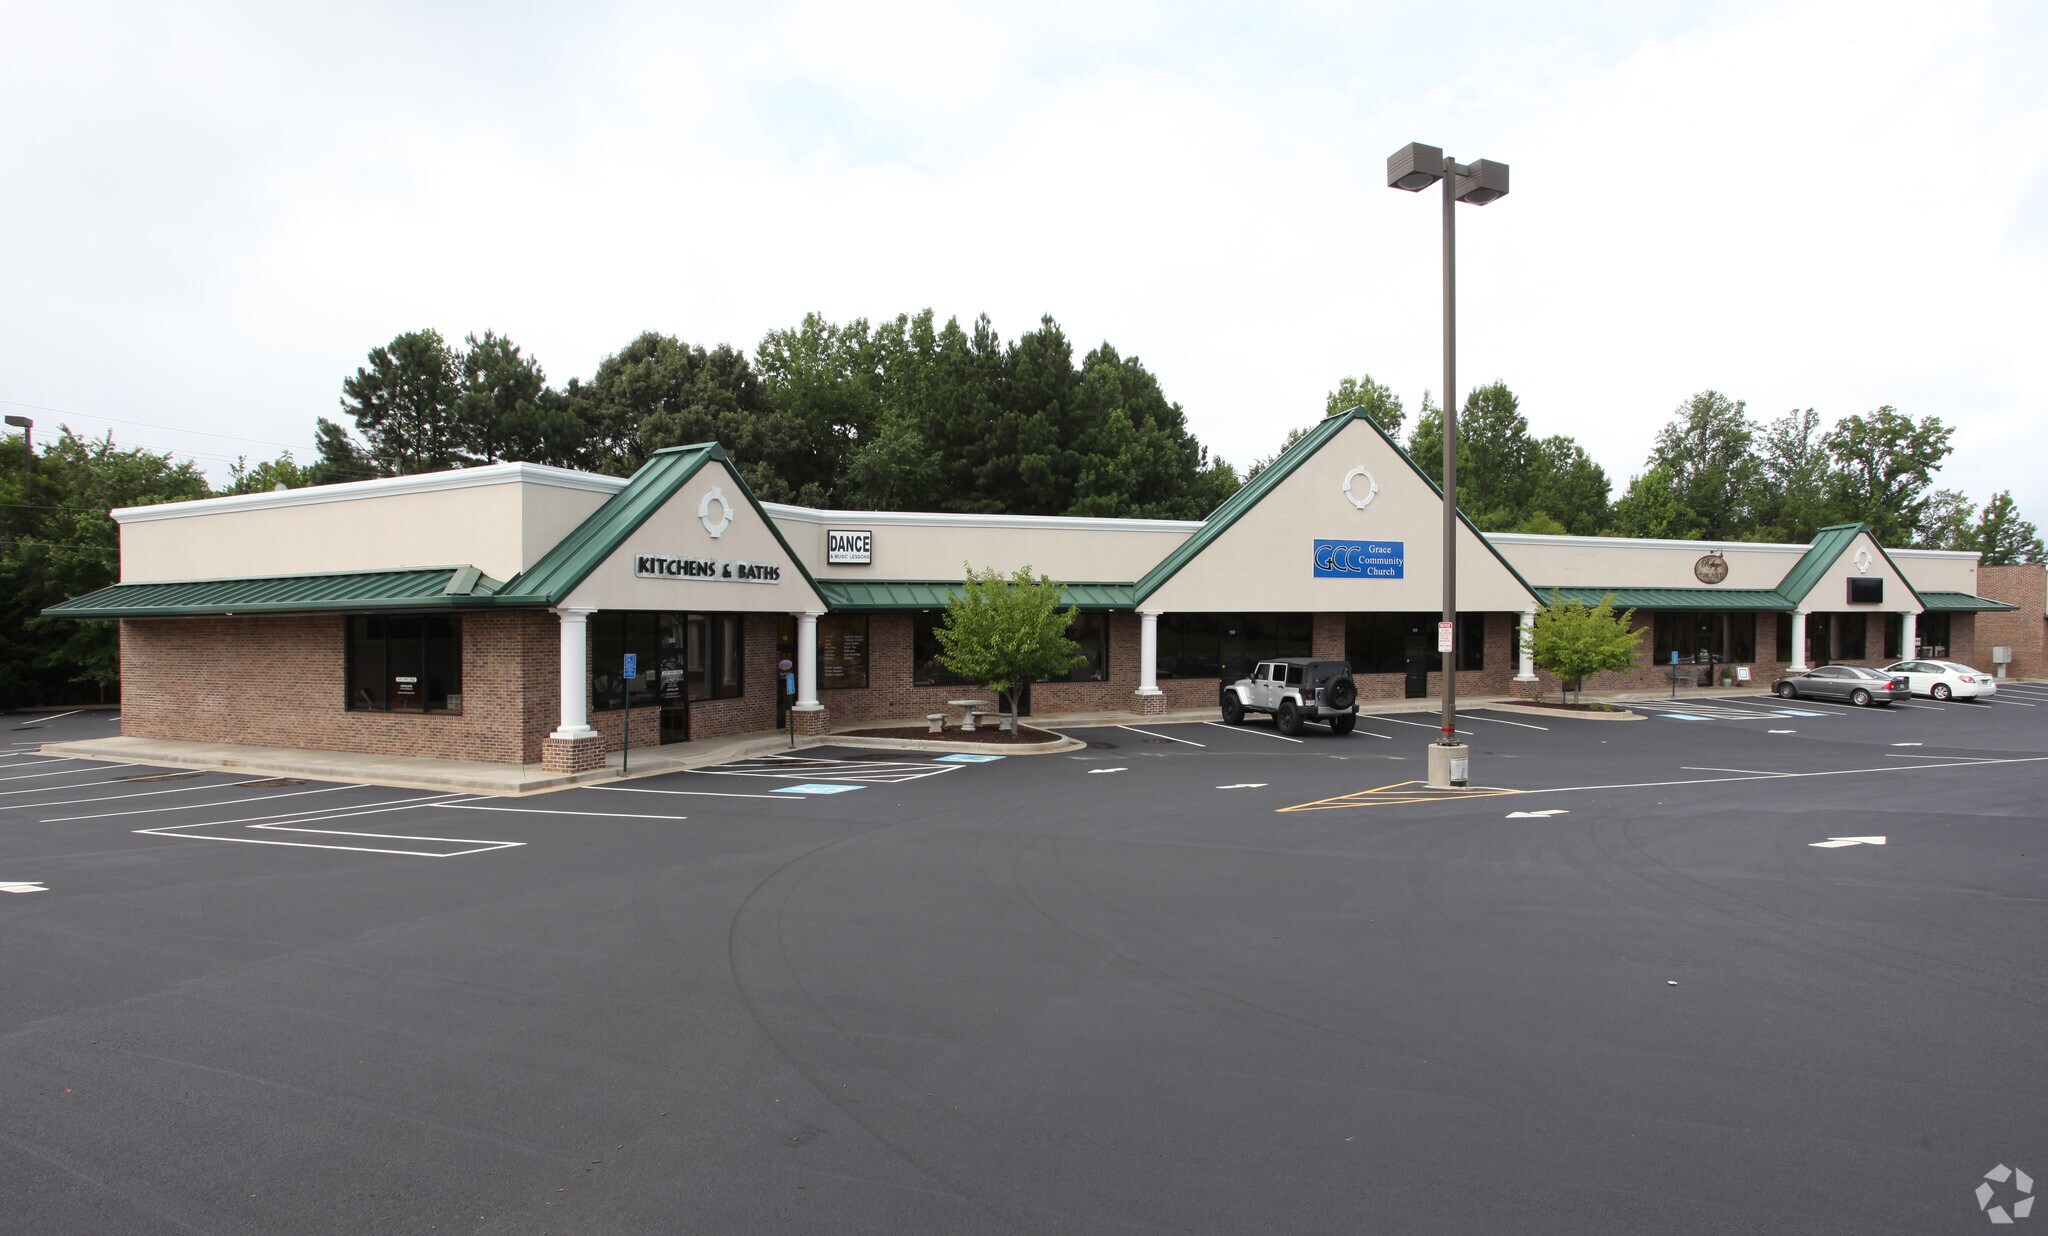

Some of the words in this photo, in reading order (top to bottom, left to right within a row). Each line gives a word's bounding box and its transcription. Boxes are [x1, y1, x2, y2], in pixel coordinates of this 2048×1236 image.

[830, 535, 870, 552] DANCE
[1368, 544, 1392, 554] Grace
[1314, 545, 1361, 572] GCC
[1359, 555, 1404, 567] Community
[637, 556, 716, 577] KITCHENS
[722, 563, 732, 579] &
[737, 564, 780, 581] BATHS
[1367, 566, 1395, 576] Church
